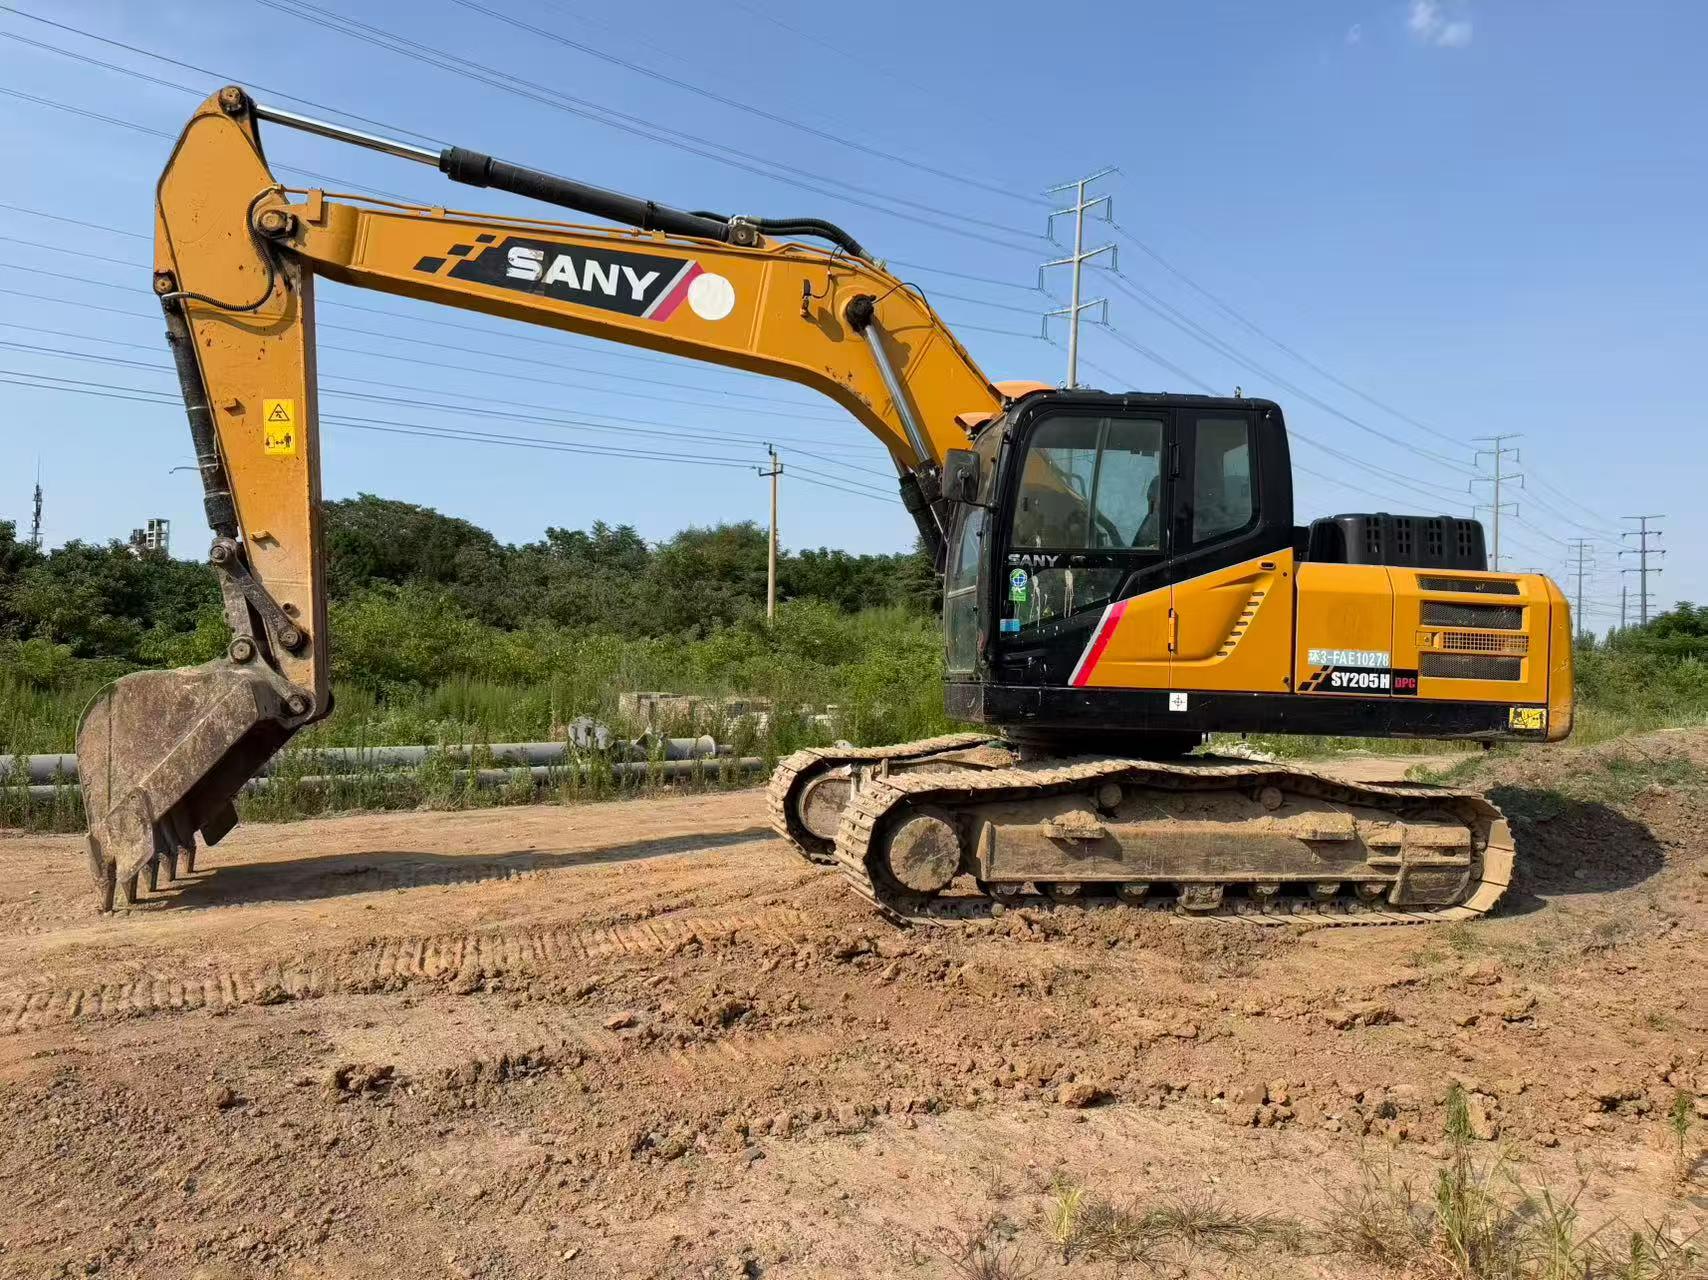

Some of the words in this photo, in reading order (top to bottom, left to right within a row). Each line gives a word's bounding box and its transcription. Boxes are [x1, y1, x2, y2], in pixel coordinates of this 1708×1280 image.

[506, 246, 660, 301] SANY
[1008, 553, 1059, 567] SANY
[1331, 671, 1390, 688] SY205H
[1395, 677, 1416, 688] DPC
